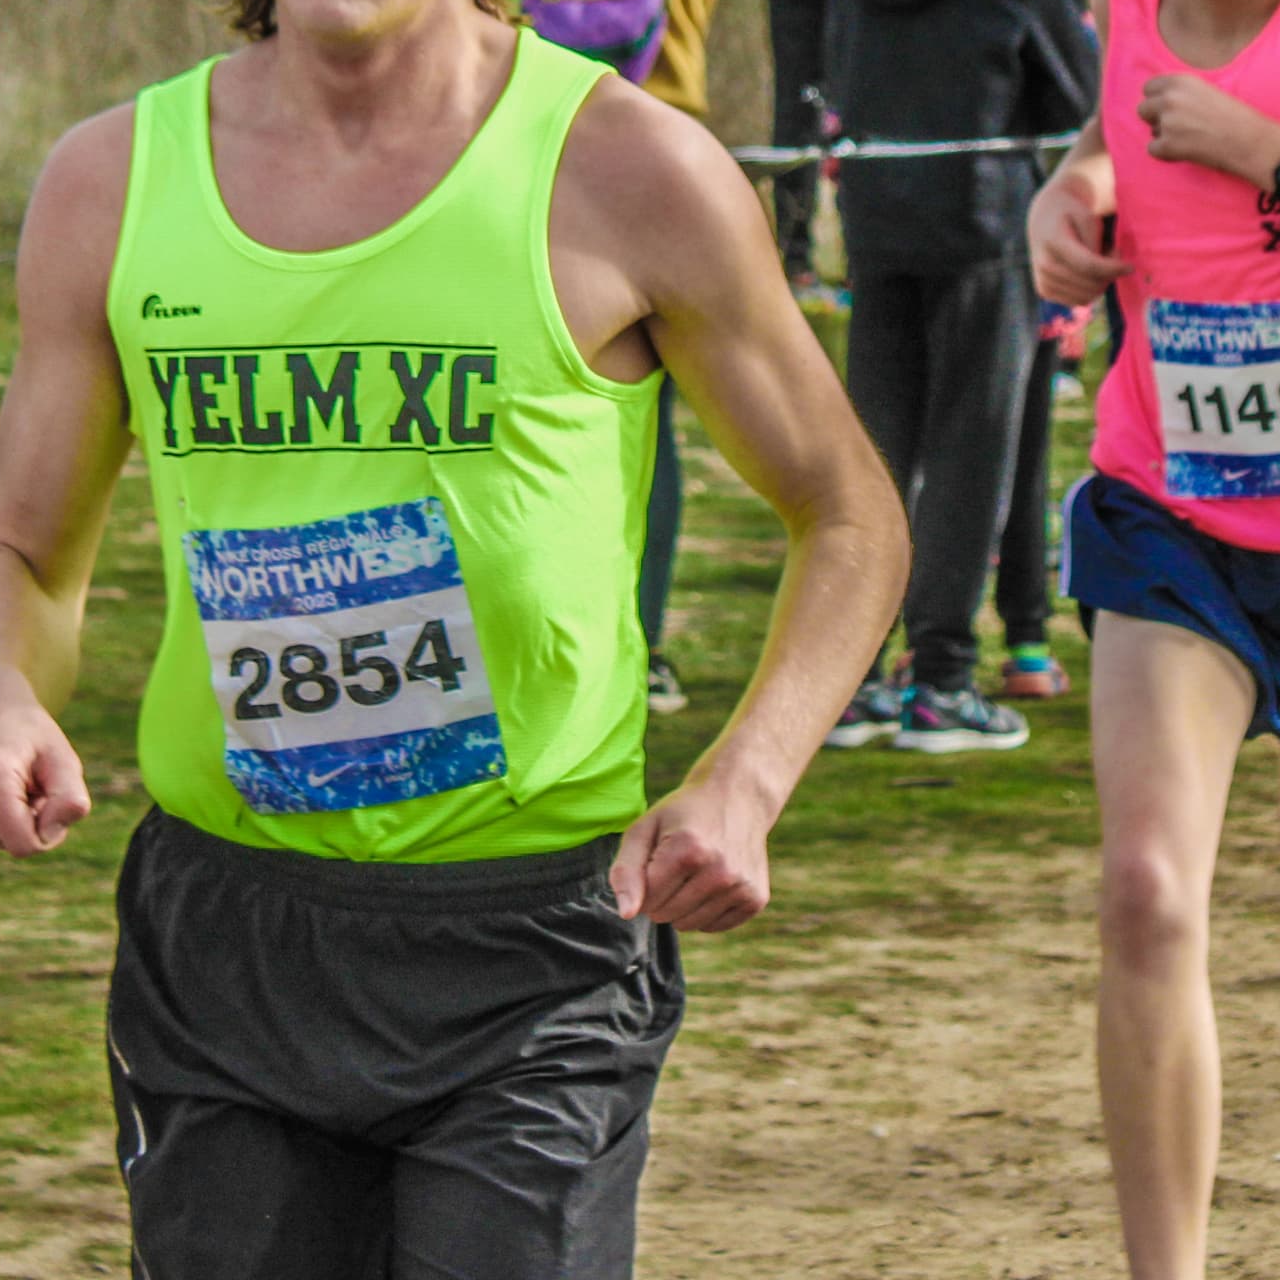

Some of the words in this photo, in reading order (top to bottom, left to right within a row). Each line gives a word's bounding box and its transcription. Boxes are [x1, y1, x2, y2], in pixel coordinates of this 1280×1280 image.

[148, 351, 362, 448] YELM
[389, 351, 497, 446] XC
[200, 535, 443, 599] NORTHWEST
[252, 544, 303, 563] CROSS
[229, 619, 466, 720] 2854
